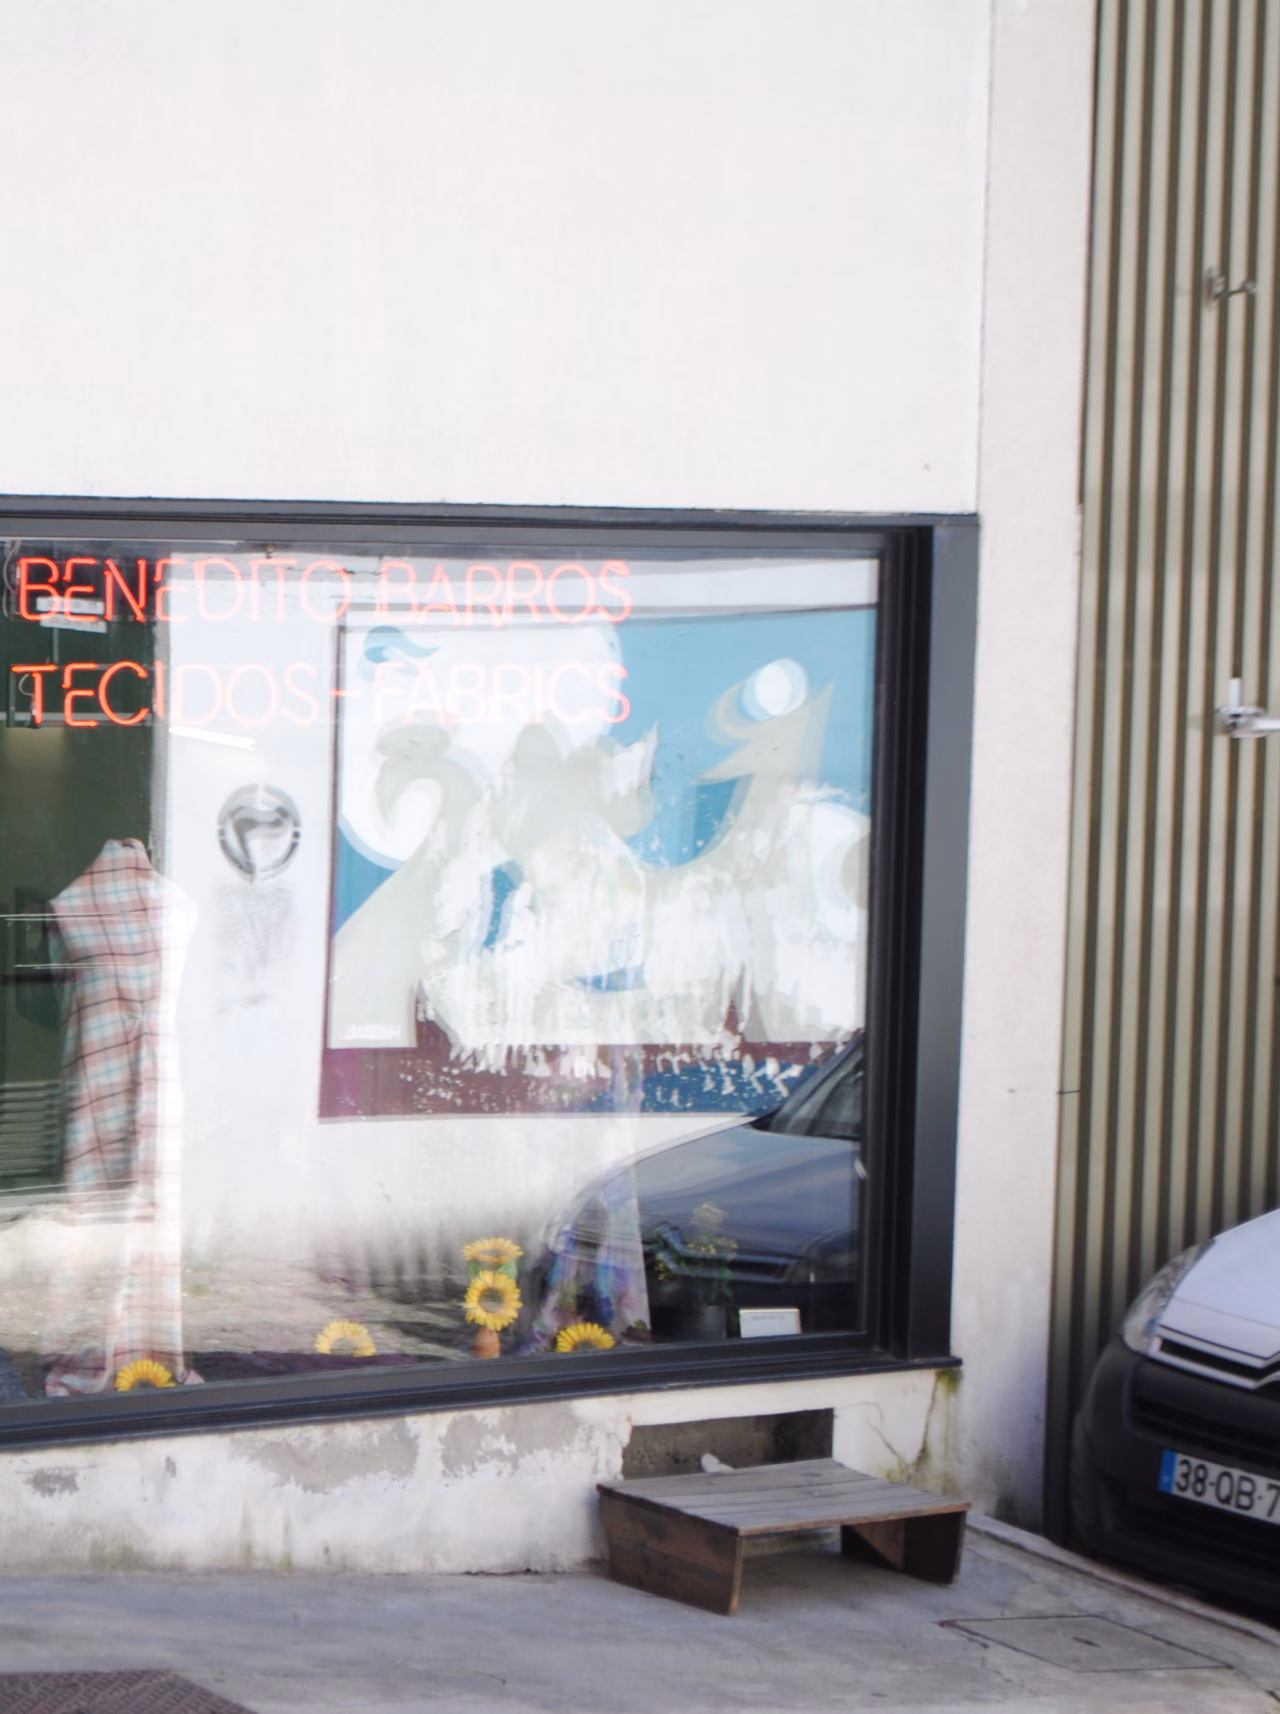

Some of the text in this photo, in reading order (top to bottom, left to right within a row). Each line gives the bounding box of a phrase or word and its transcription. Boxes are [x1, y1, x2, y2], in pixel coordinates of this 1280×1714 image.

[17, 556, 633, 627] BENEDITO BARROS
[11, 660, 320, 727] TECIDOS
[372, 660, 631, 724] FABRICS
